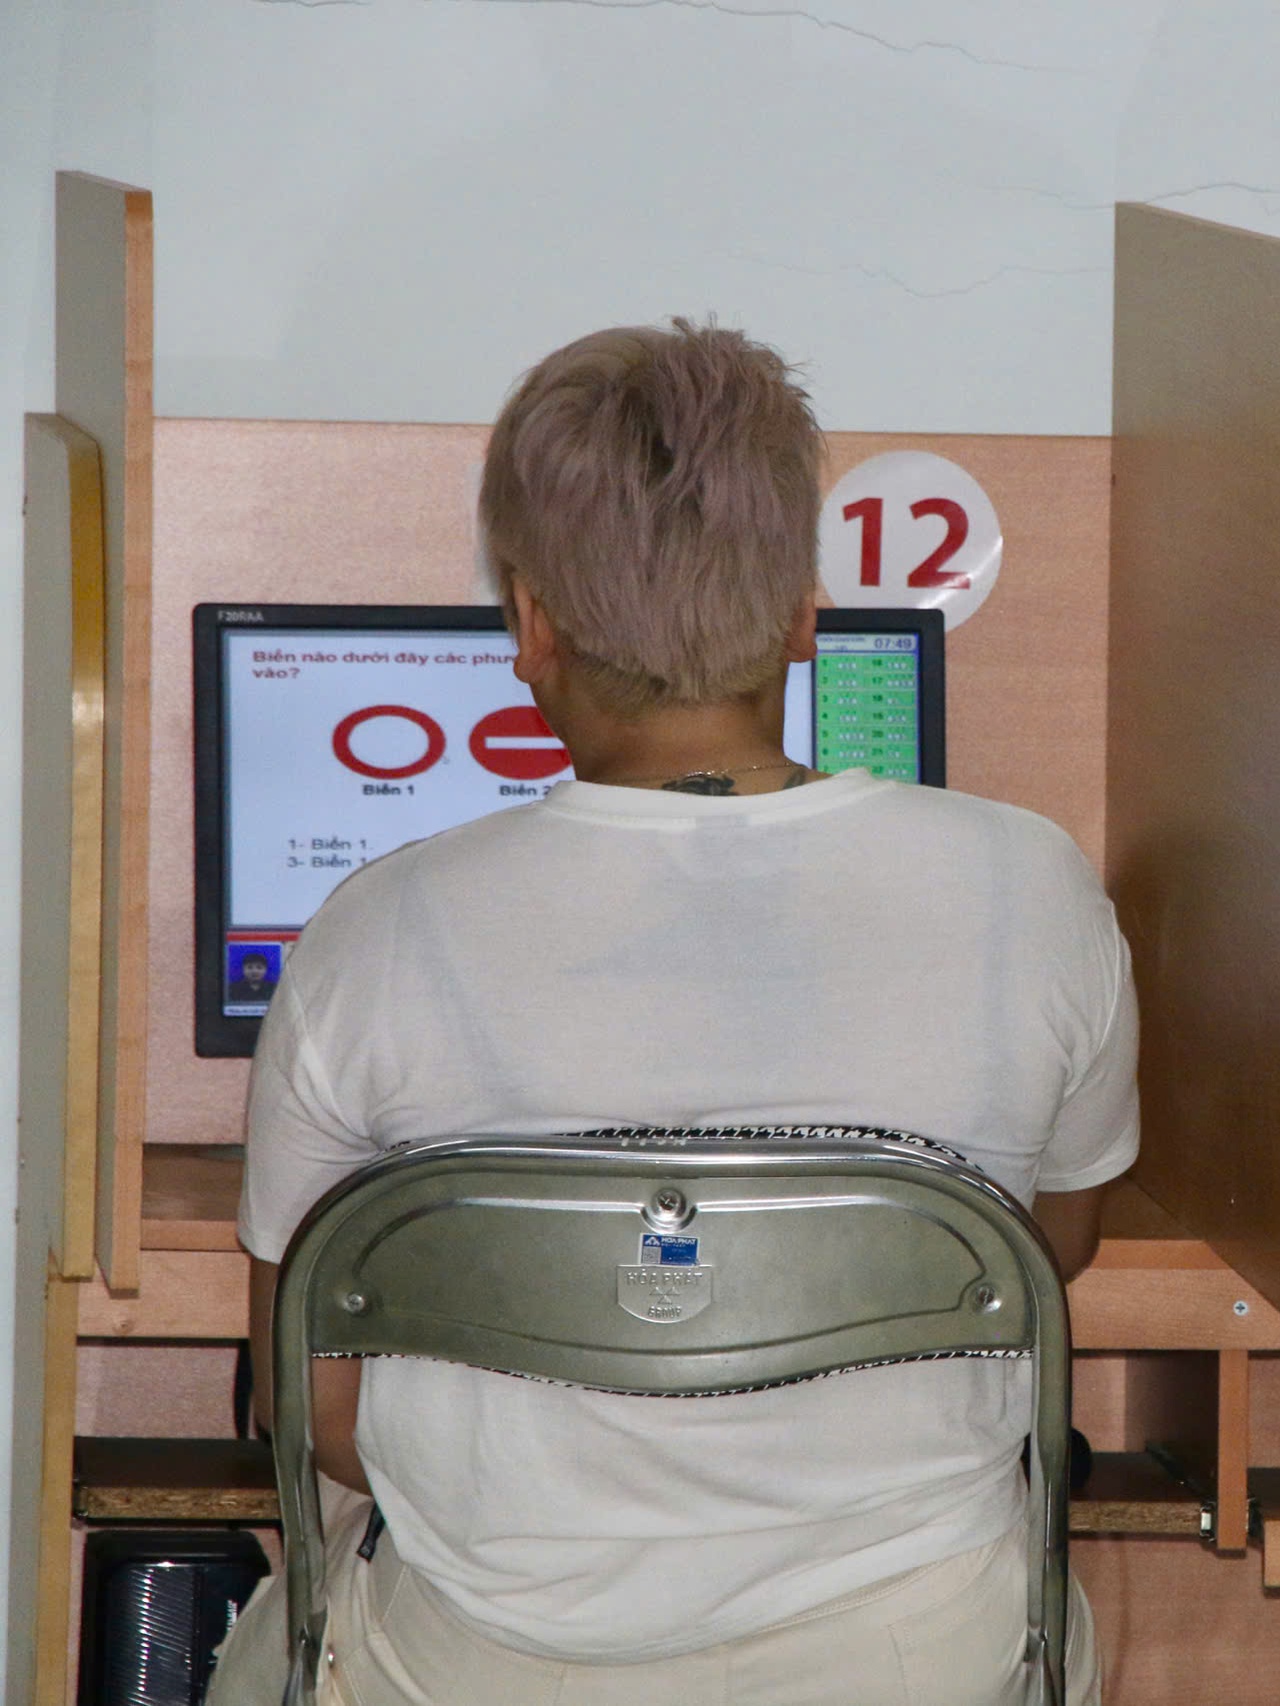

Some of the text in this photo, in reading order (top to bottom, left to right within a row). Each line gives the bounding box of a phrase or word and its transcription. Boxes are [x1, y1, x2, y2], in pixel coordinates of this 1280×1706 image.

[842, 497, 970, 590] 12
[217, 611, 264, 622] F20RAA
[874, 637, 912, 650] 07:49
[433, 651, 467, 664] các
[405, 784, 415, 796] 1
[288, 838, 303, 850] 1-
[287, 857, 303, 868] 3-
